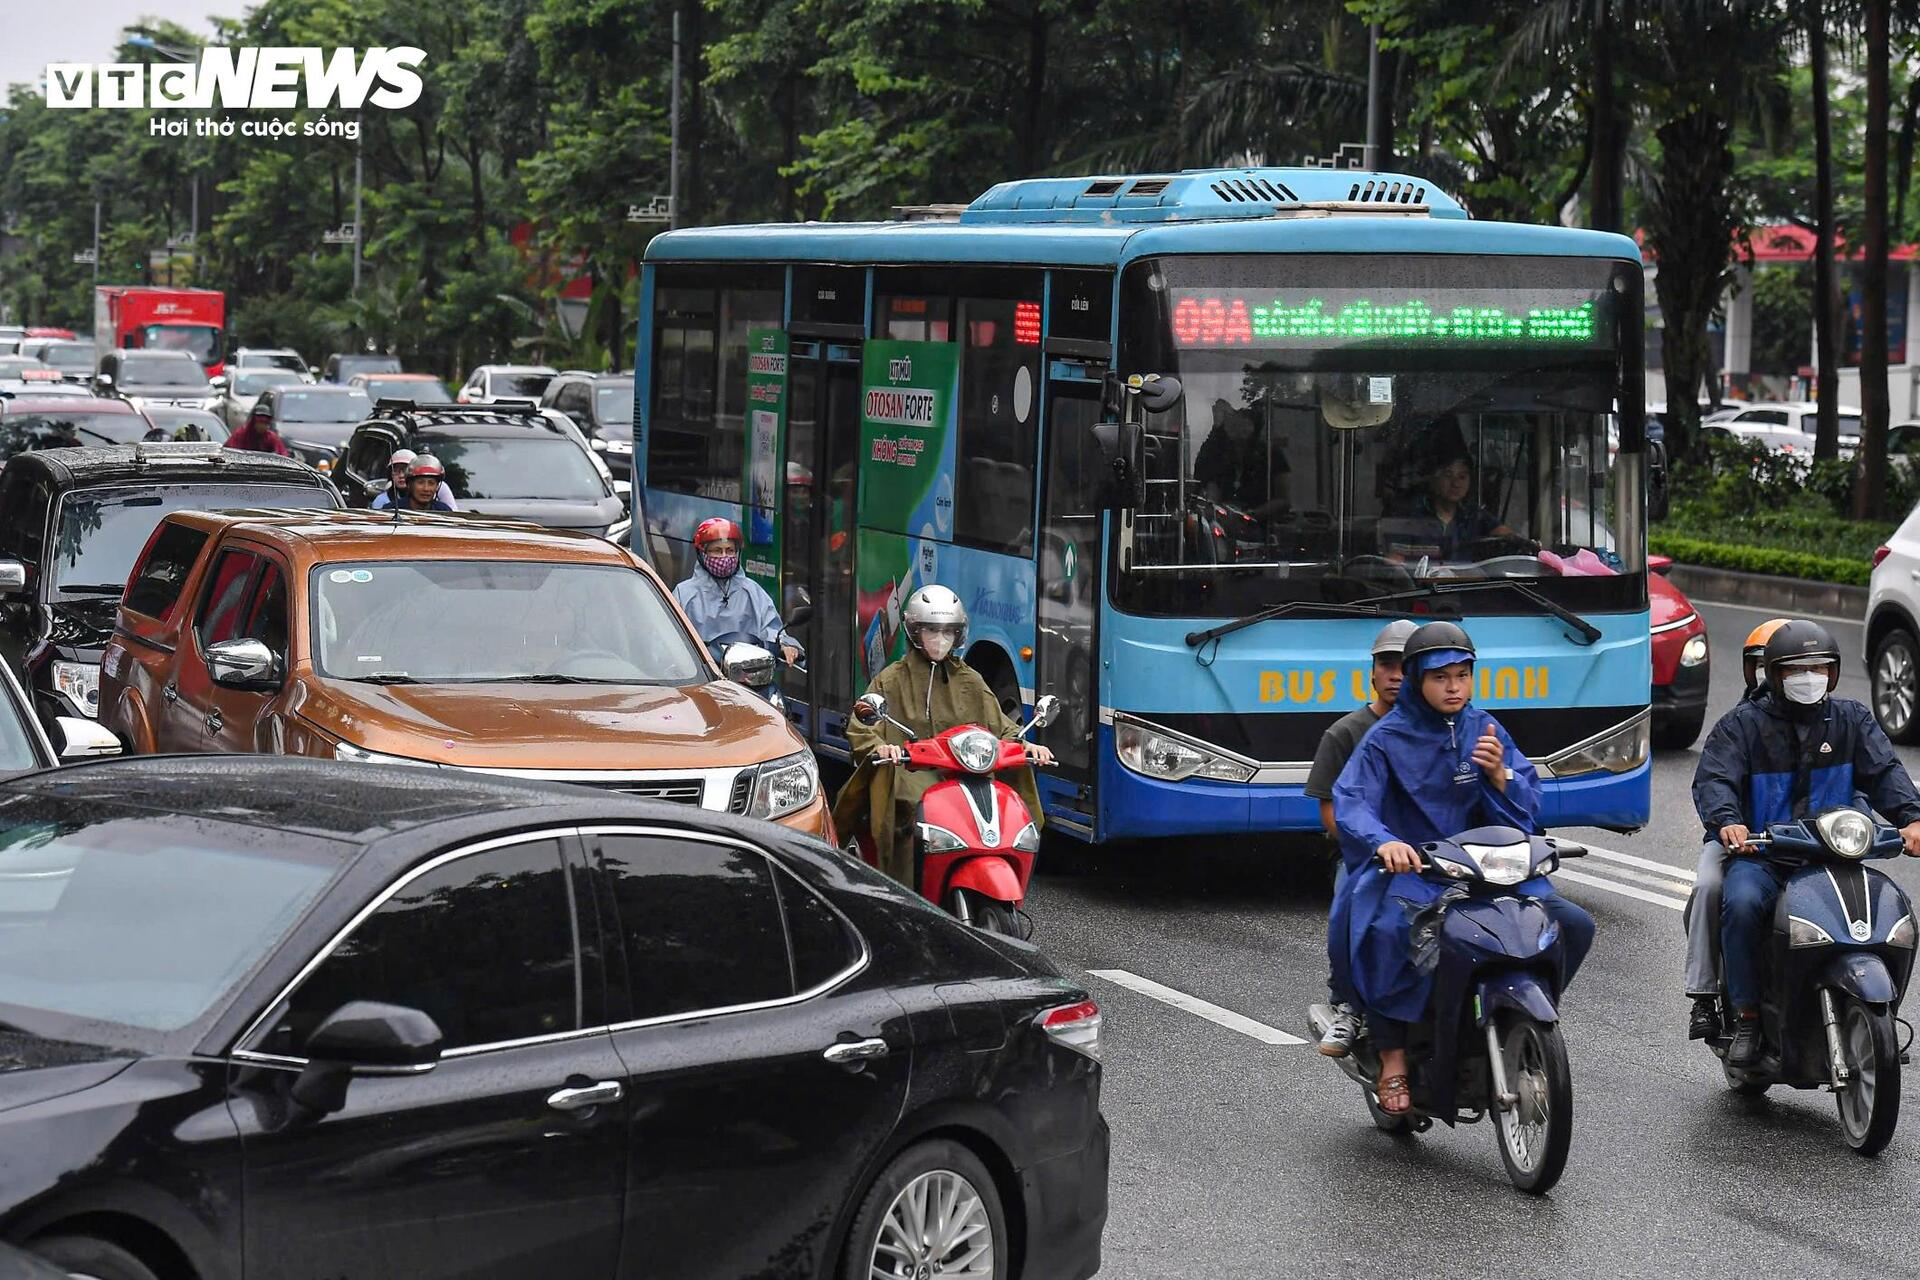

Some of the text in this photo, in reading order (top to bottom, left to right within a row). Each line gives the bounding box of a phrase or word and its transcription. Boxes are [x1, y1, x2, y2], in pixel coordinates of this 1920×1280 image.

[866, 391, 933, 422] OTOSAN FORTE
[872, 434, 898, 463] KHÔNG
[1259, 670, 1337, 703] BUS
[1472, 666, 1550, 700] INH
